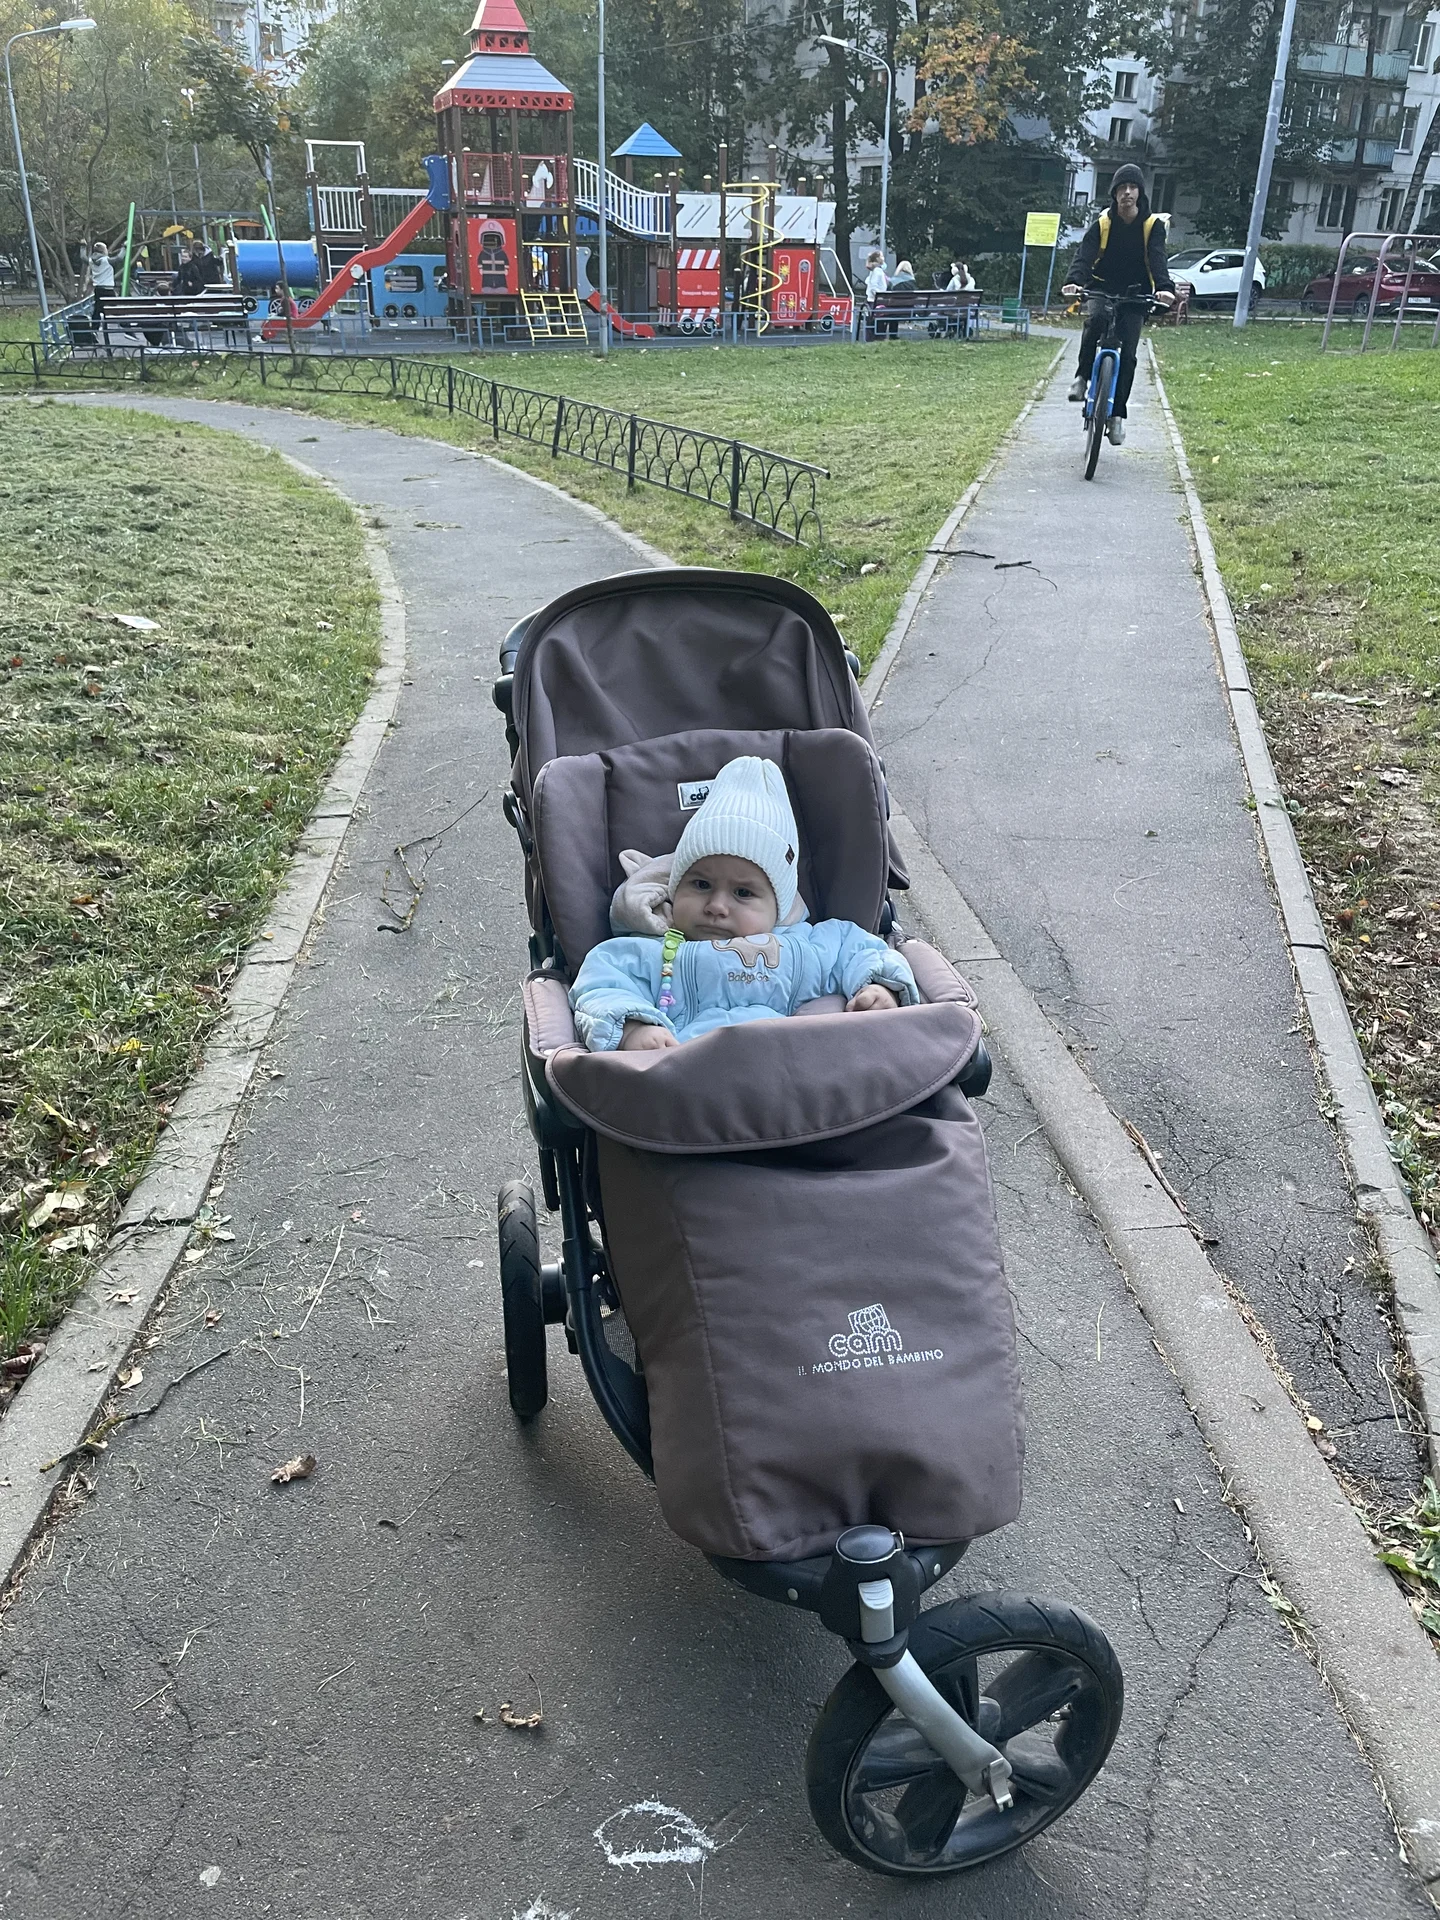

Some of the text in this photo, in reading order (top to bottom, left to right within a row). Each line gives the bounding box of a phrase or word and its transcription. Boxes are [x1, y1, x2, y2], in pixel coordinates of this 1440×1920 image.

[830, 304, 841, 316] 01
[828, 1328, 902, 1357] cam
[798, 1349, 944, 1376] IL MONDO DEL BAMBINO
